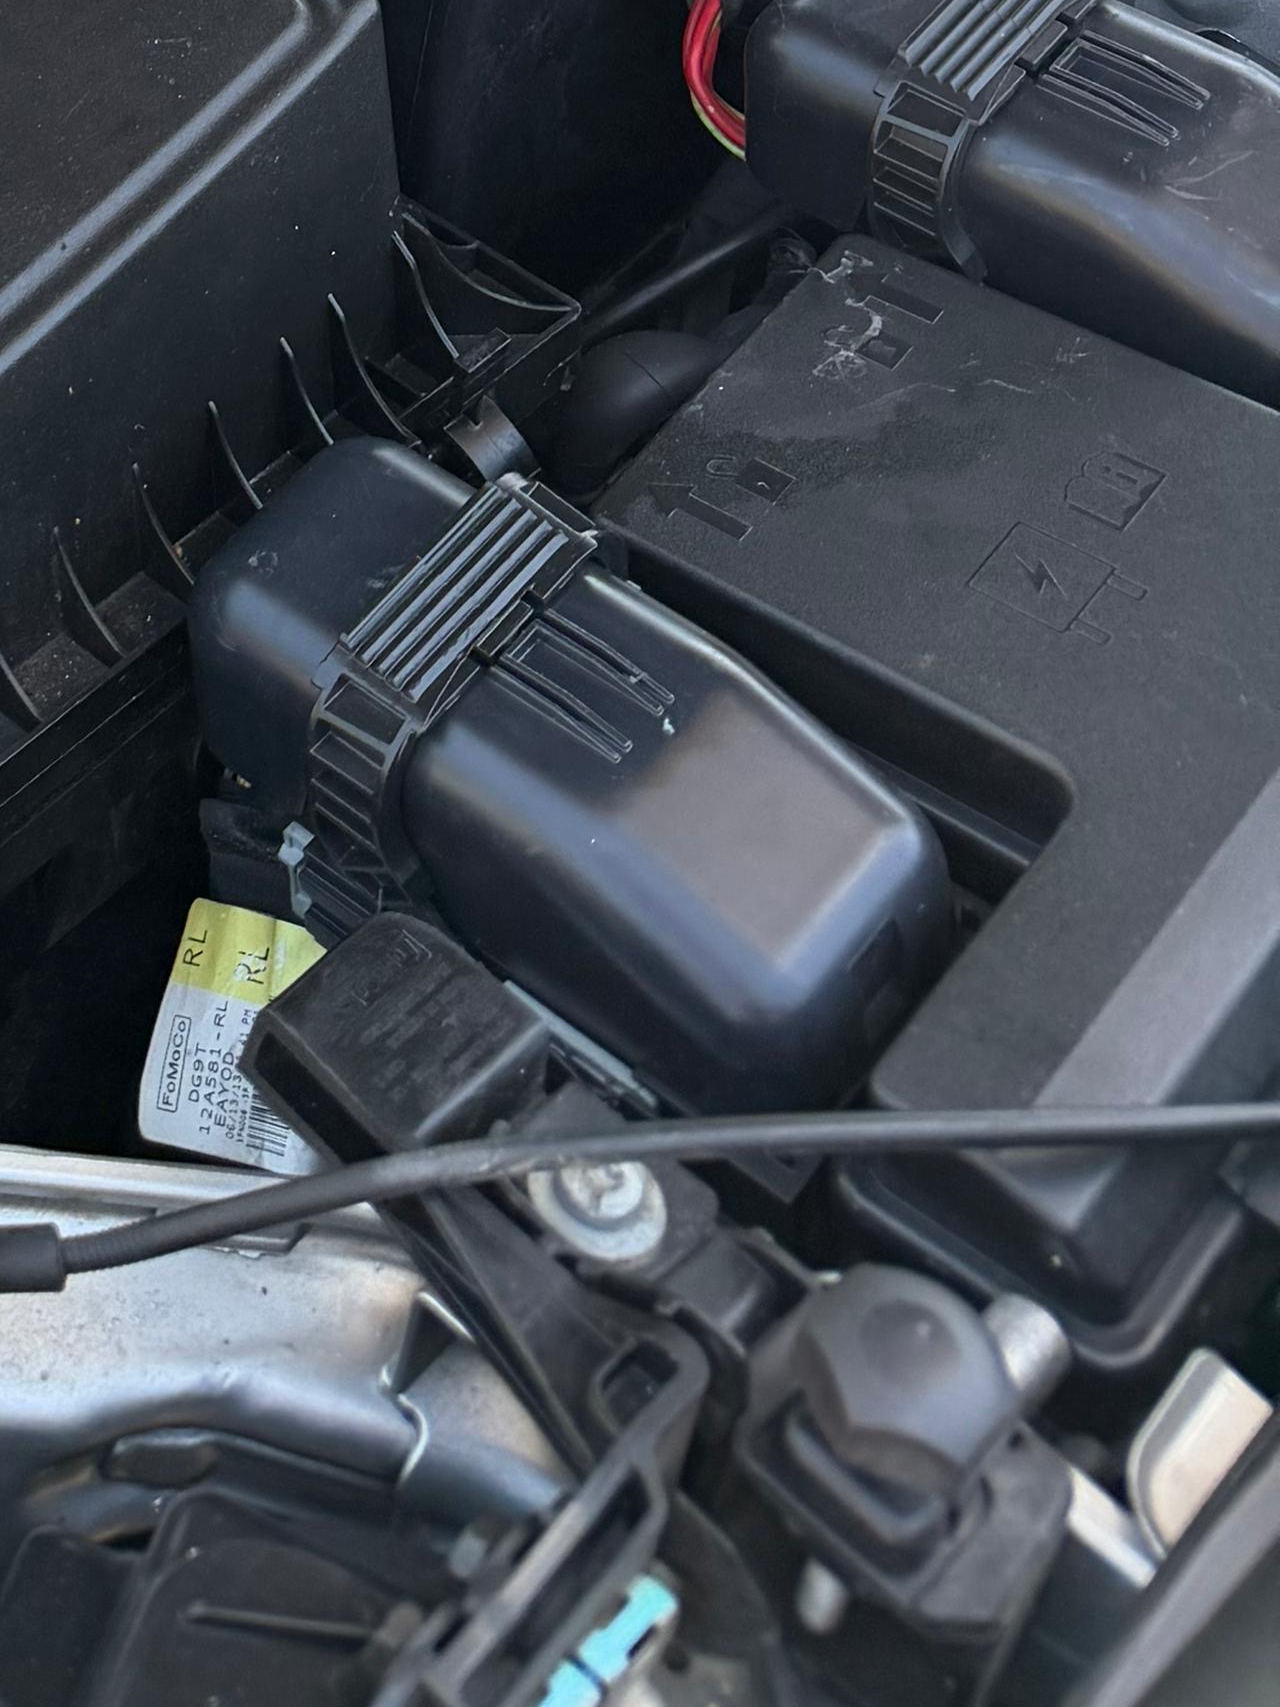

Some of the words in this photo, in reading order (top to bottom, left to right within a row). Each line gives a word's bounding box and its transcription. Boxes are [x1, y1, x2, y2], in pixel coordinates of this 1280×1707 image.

[183, 928, 208, 967] RL
[161, 1019, 188, 1109] FoMoCo
[187, 1042, 209, 1103] DG9T
